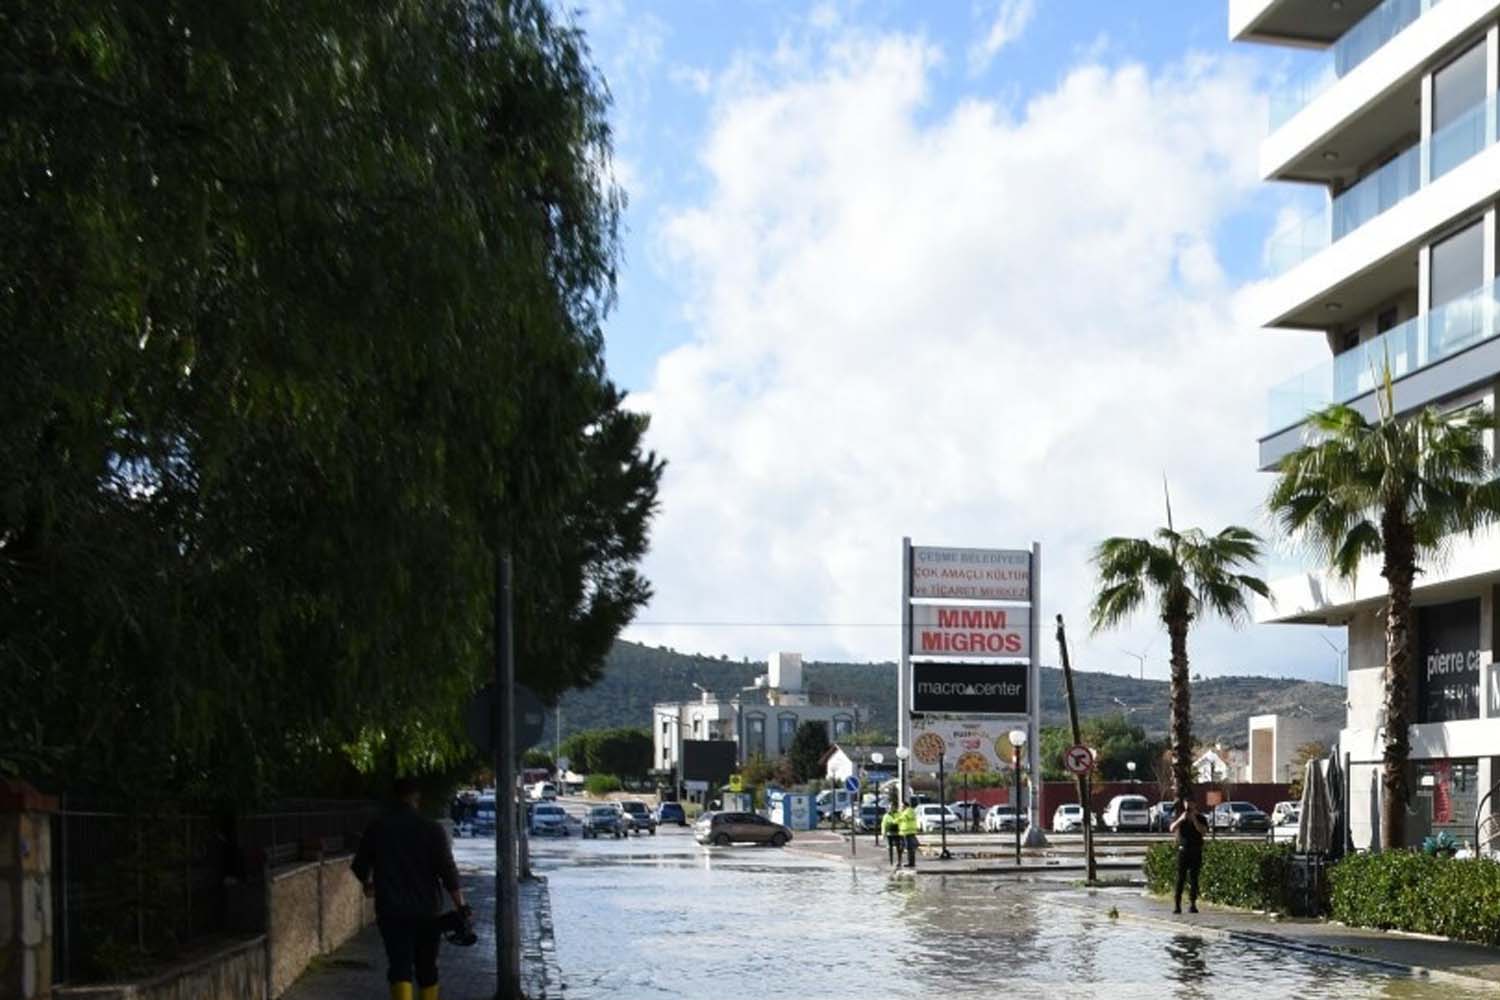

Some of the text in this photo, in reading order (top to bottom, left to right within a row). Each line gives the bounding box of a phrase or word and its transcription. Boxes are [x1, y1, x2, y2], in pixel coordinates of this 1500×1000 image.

[937, 608, 1007, 630] MMM
[921, 630, 1022, 653] MiGROS
[1427, 648, 1464, 682] pierre
